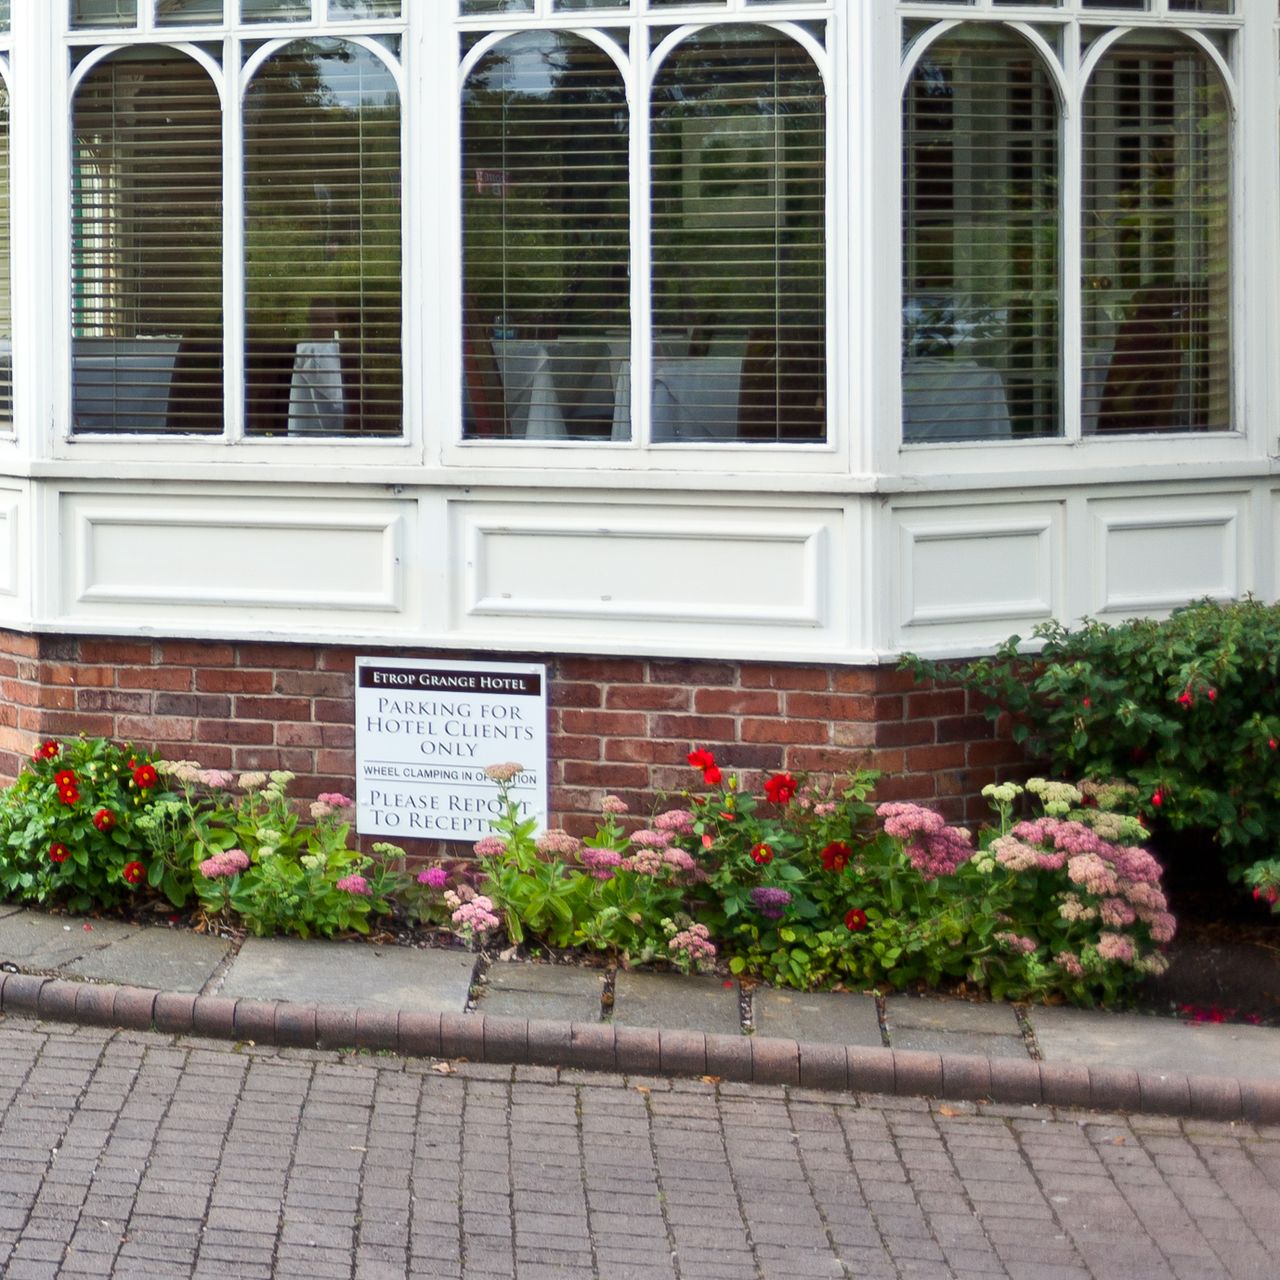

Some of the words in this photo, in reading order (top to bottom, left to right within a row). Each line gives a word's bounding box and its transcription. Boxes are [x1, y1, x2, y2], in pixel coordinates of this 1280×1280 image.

[373, 671, 416, 686] ETROP
[419, 673, 476, 688] GRANGE
[480, 676, 527, 690] HOTEL
[378, 697, 471, 718] PARKING
[481, 704, 522, 720] FOR
[367, 717, 438, 736] HOTEL
[444, 720, 534, 740] CLIENTS
[420, 741, 478, 757] ONLY
[364, 766, 399, 777] WHEEL
[403, 768, 459, 780] CLAMPING
[462, 771, 472, 781] IN
[370, 790, 440, 810] PLEASE
[449, 795, 531, 815] REPOT
[373, 810, 400, 827] TO
